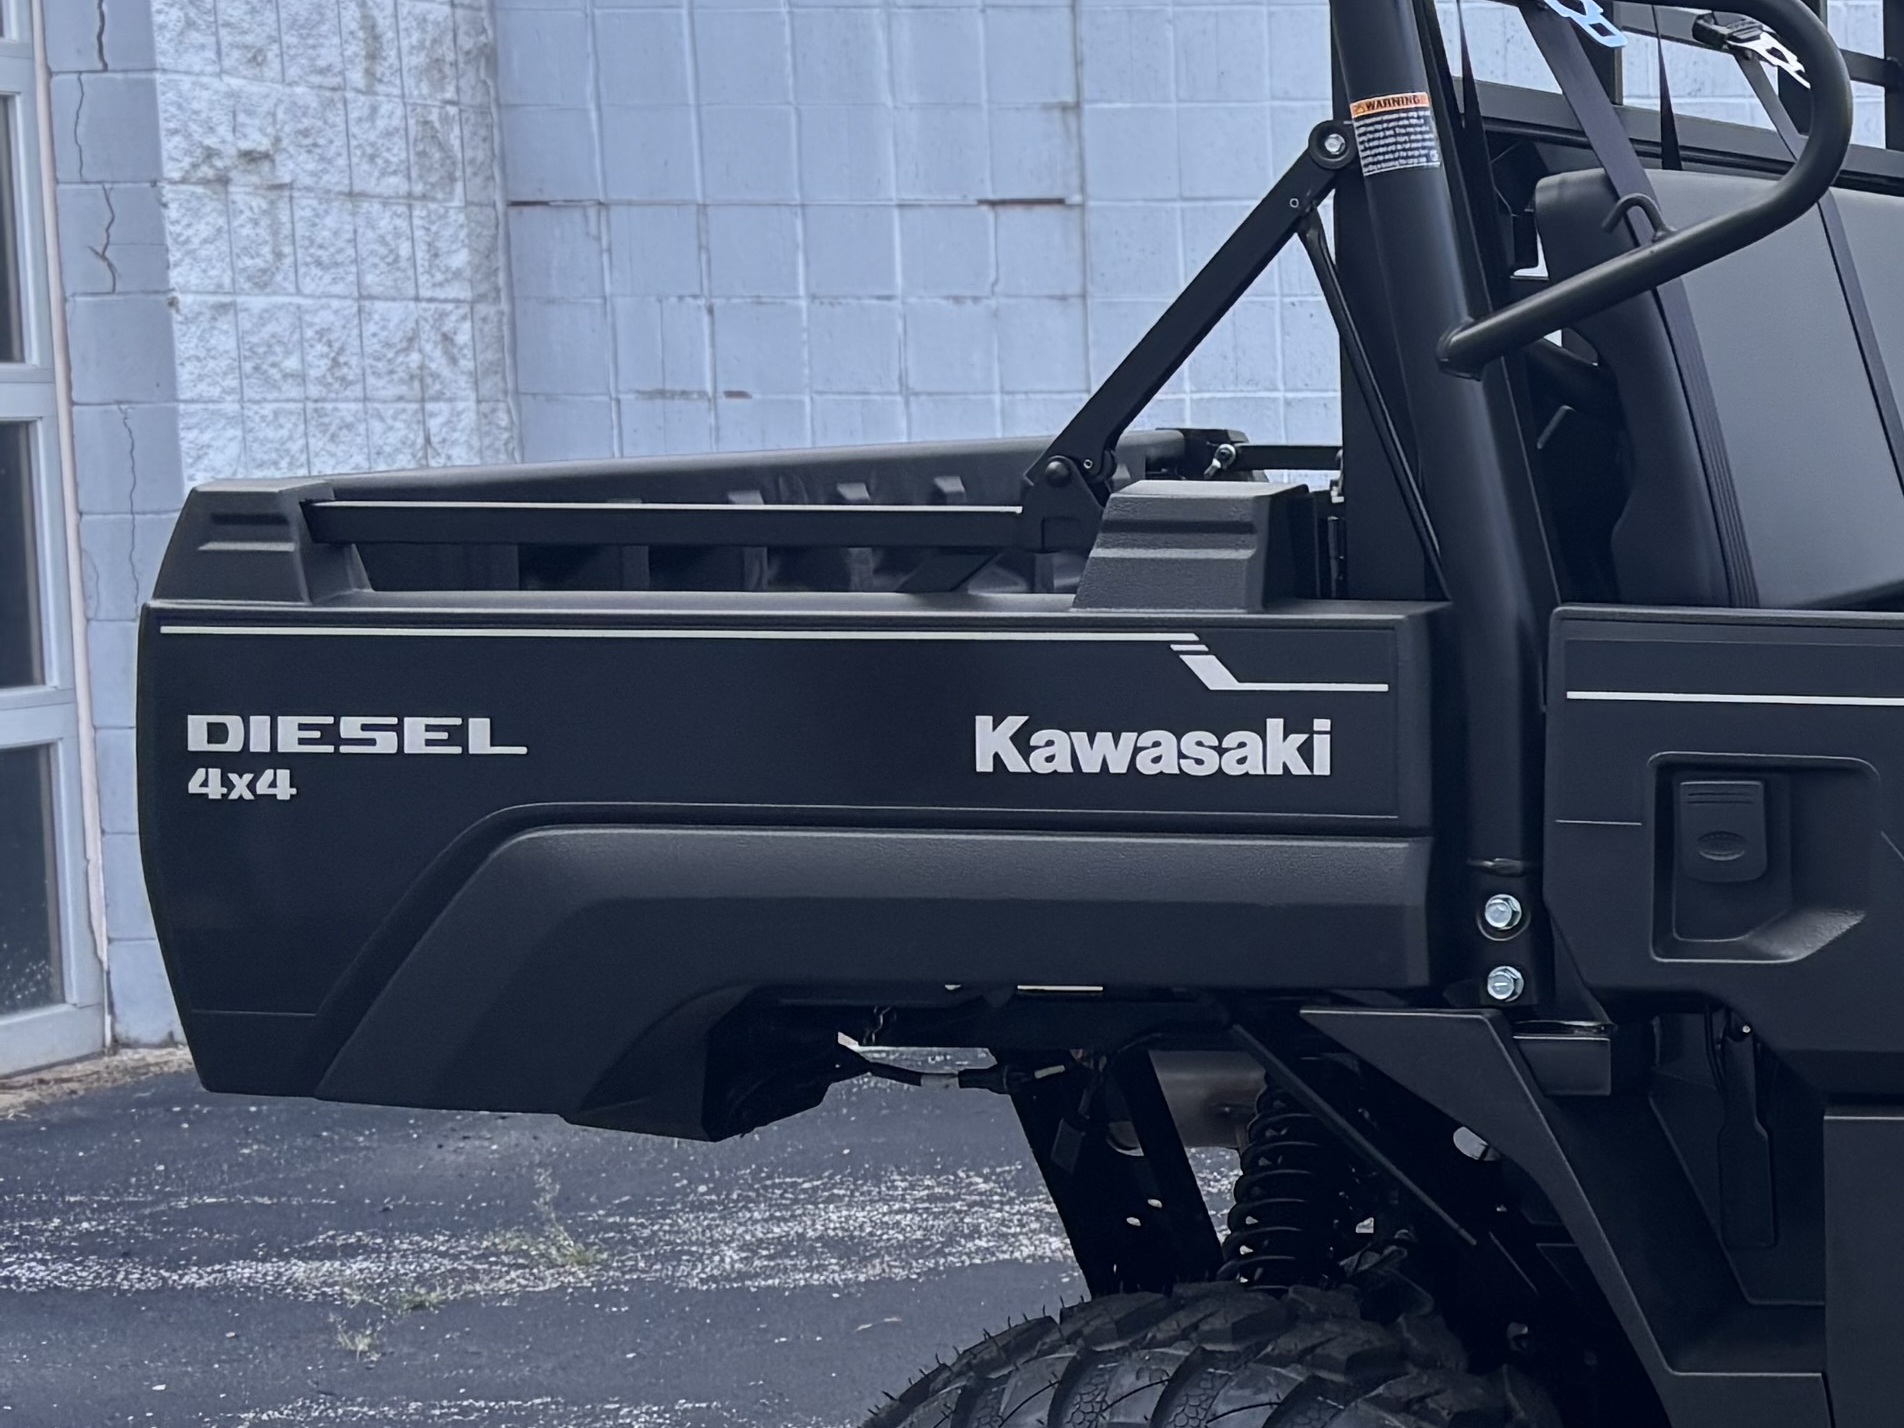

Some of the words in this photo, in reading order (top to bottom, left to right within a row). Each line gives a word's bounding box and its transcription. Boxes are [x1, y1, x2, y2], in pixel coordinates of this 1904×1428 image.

[1365, 94, 1420, 111] WARNING
[187, 714, 528, 755] DIESEL
[975, 714, 1331, 776] Kawasaki
[187, 767, 297, 801] 4x4
